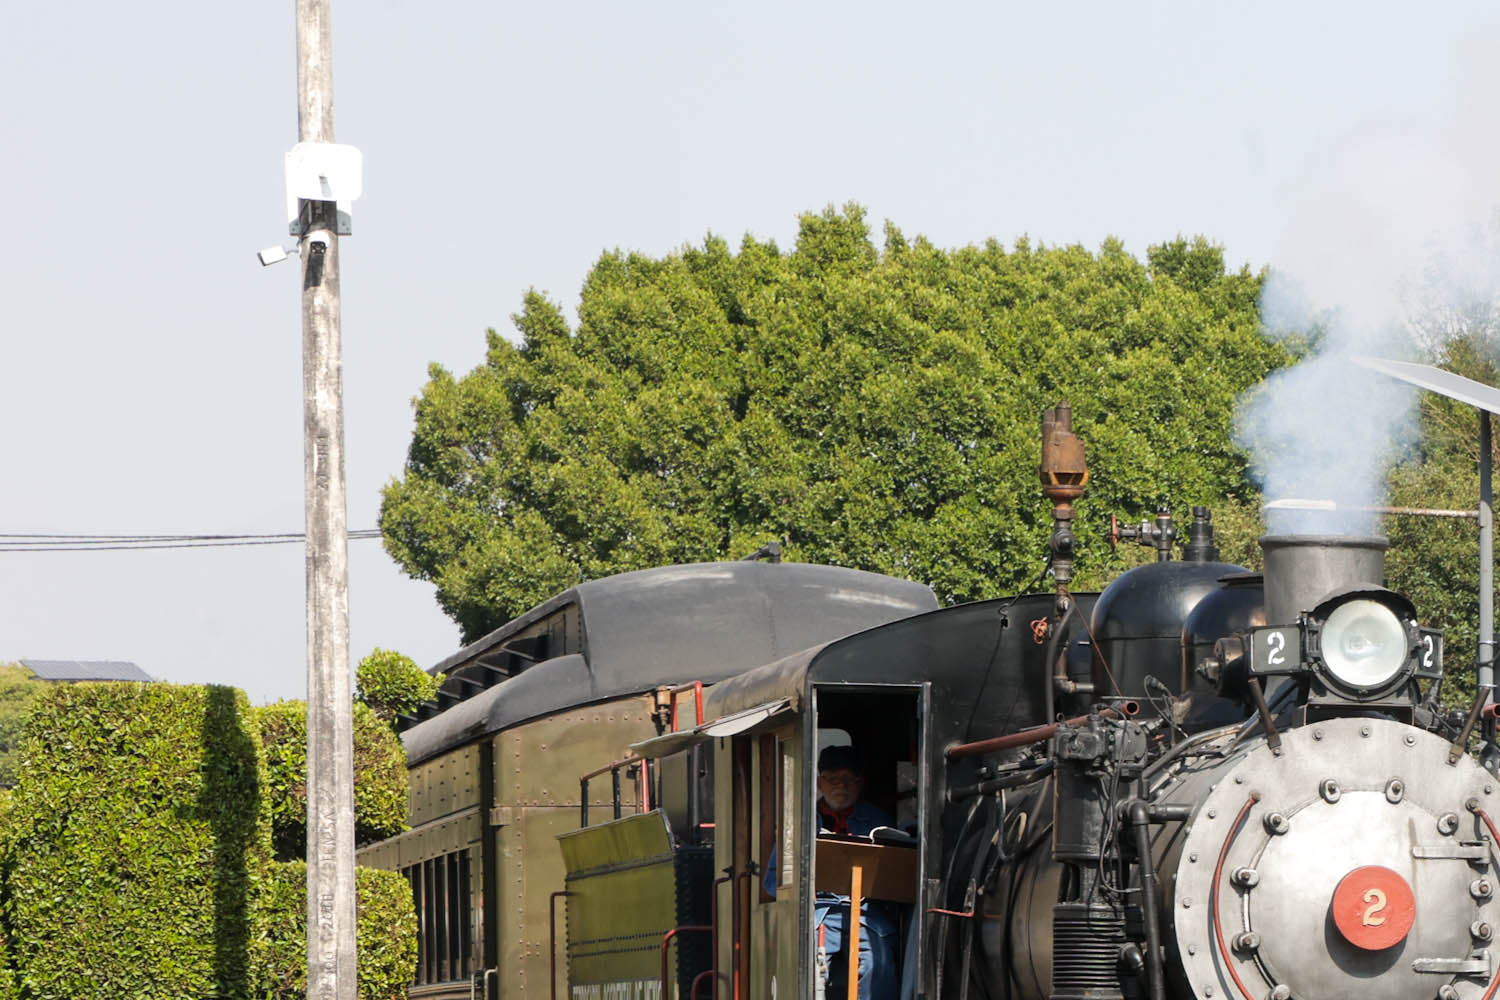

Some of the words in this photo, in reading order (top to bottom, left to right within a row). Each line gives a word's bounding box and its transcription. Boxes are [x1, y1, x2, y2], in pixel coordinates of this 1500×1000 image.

[1267, 632, 1285, 665] 2
[1423, 634, 1433, 668] 2
[1362, 887, 1387, 927] 2
